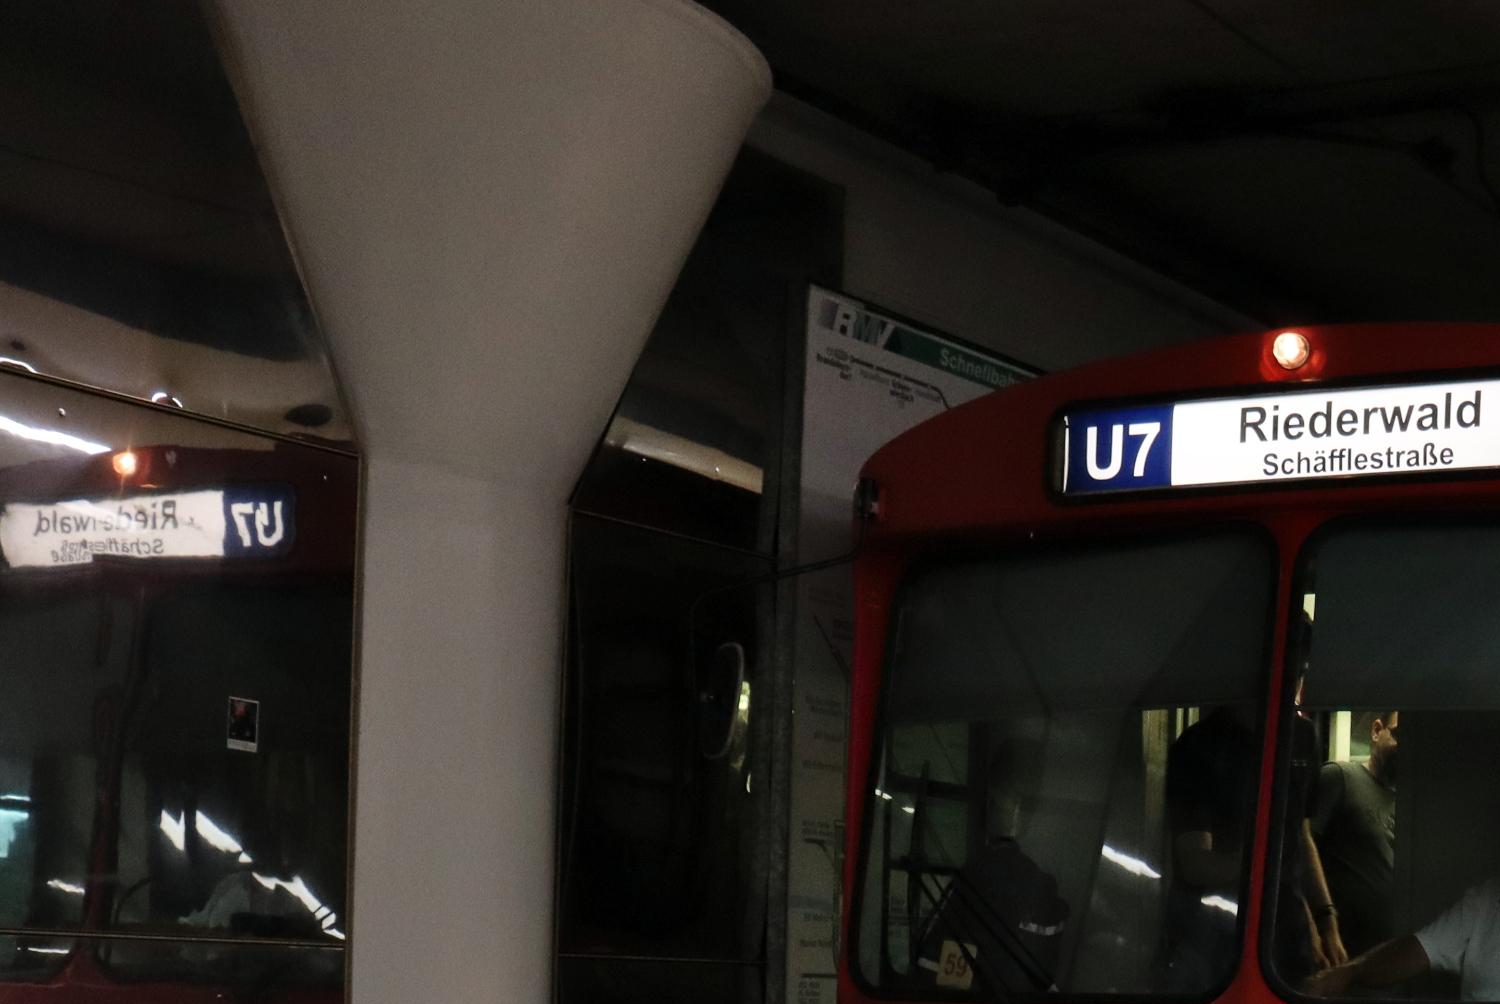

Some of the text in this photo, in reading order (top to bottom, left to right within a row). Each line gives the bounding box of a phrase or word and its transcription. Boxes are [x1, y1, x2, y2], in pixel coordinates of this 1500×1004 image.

[832, 304, 896, 349] RMV
[939, 347, 1020, 388] Schnellbah
[1085, 389, 1483, 482] U7 Riederwald
[1262, 442, 1455, 477] Schäfflestraße
